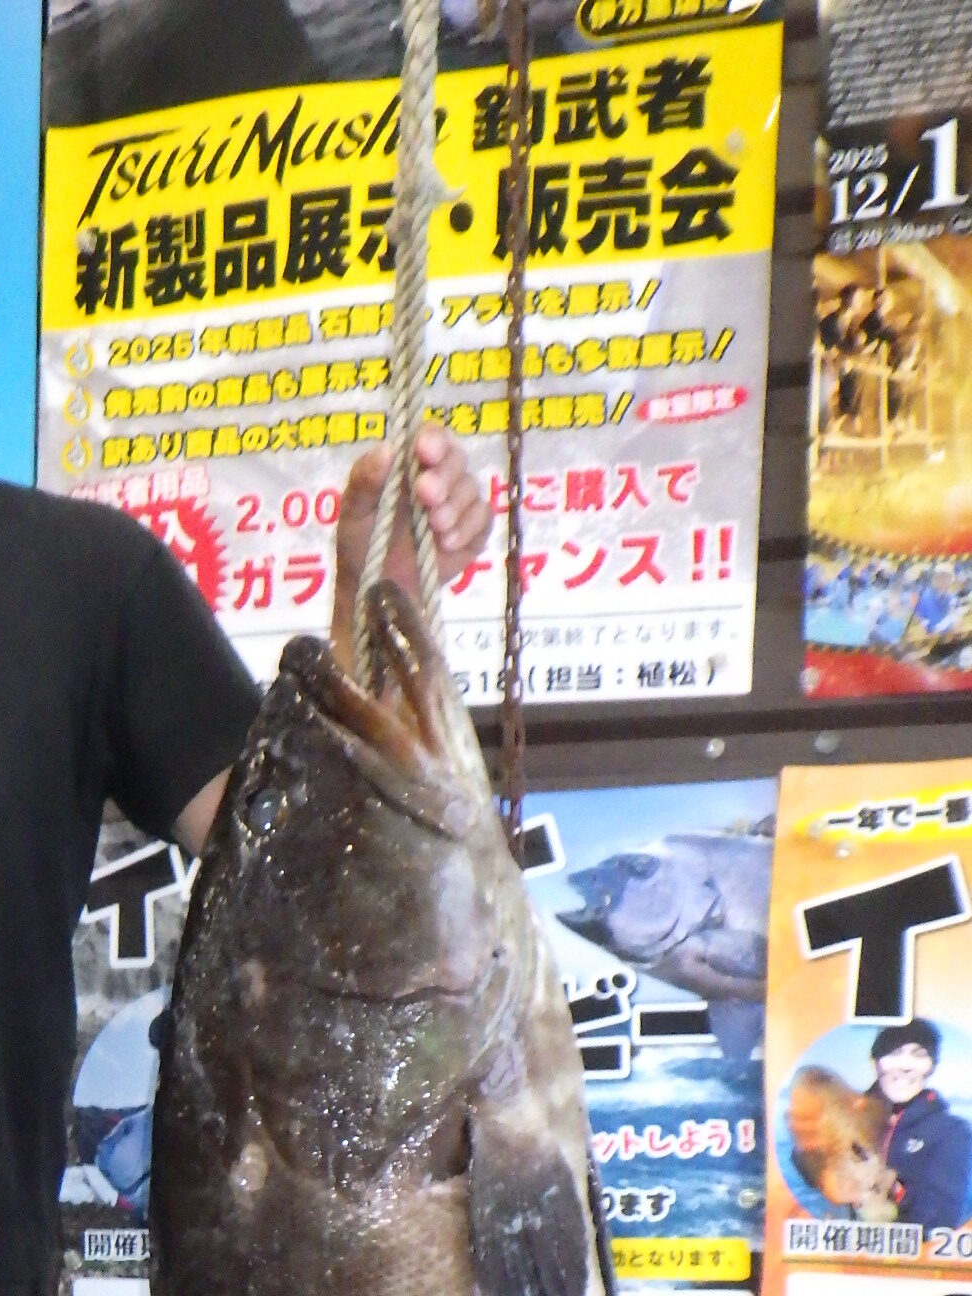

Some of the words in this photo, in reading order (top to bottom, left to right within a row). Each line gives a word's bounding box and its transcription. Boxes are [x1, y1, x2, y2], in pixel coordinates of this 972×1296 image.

[473, 57, 713, 152] 釣武者
[86, 1233, 149, 1257] 開催
